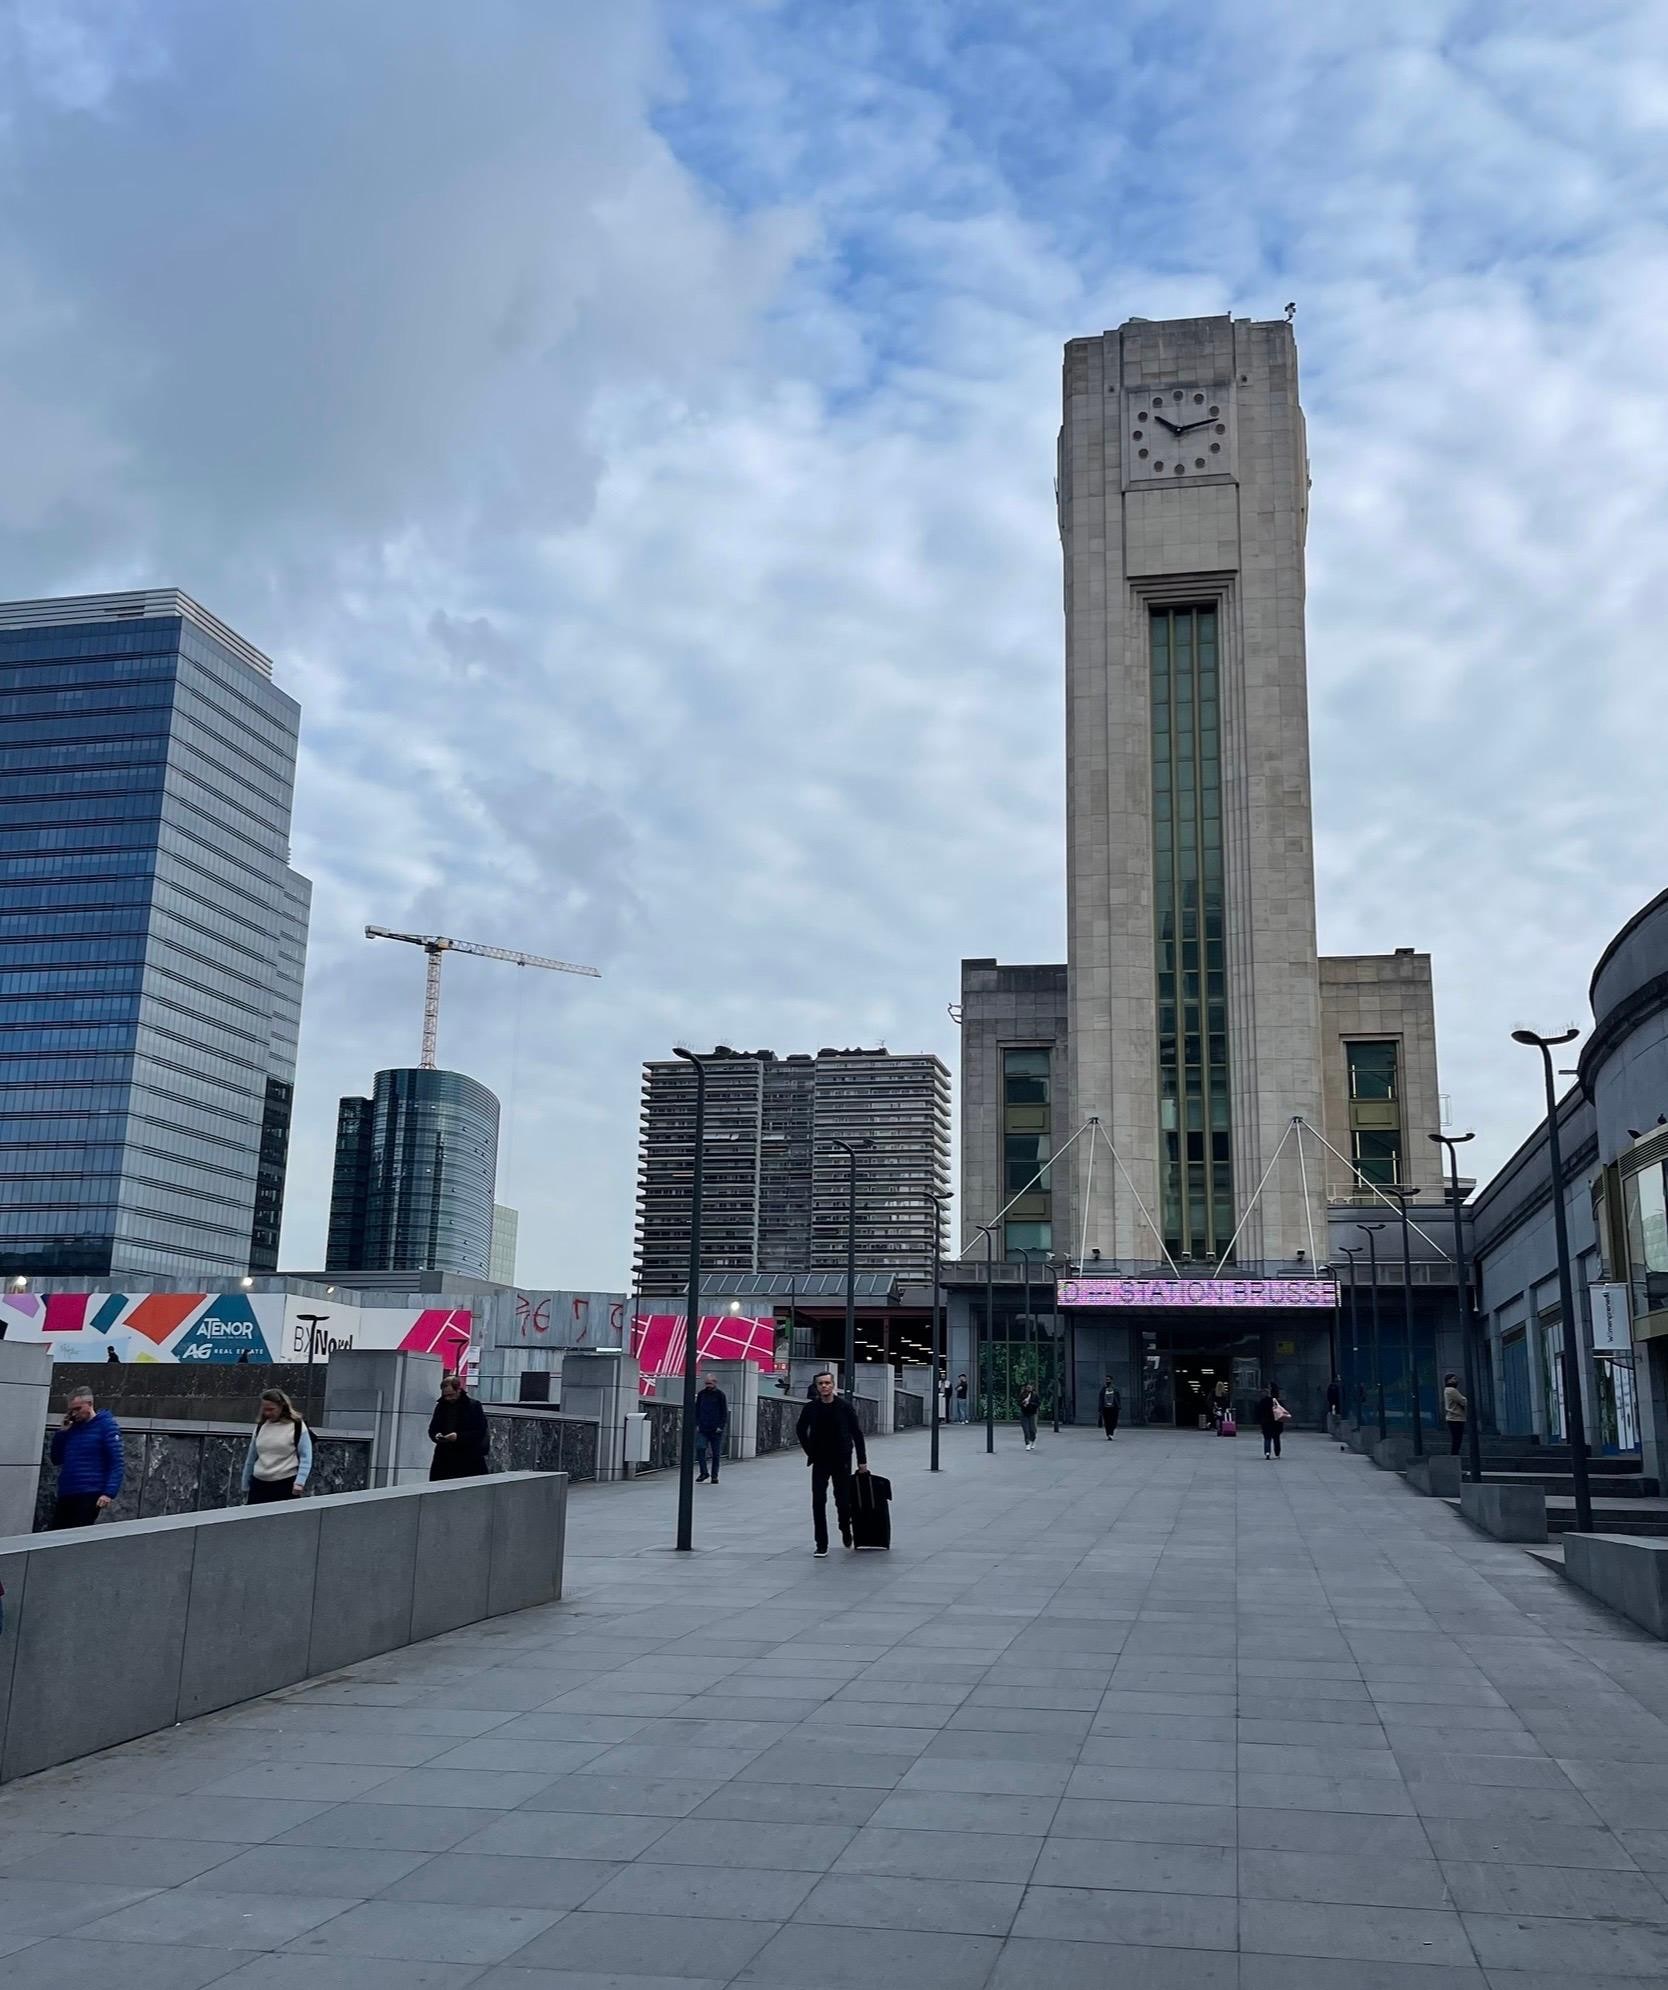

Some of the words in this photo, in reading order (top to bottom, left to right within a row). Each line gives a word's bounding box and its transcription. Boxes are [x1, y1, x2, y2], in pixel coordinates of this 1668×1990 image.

[1120, 1281, 1223, 1304] STATION
[196, 1318, 253, 1339] ATENOR
[182, 1344, 213, 1359] AG
